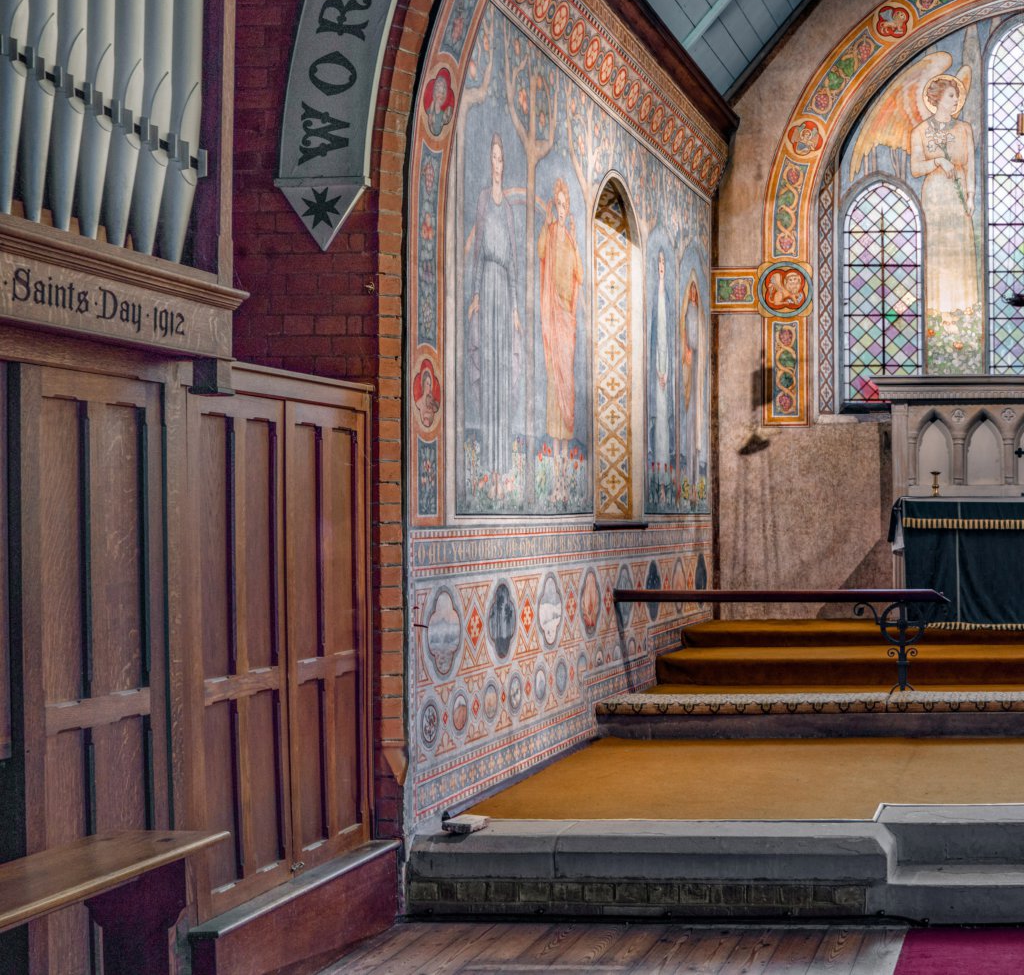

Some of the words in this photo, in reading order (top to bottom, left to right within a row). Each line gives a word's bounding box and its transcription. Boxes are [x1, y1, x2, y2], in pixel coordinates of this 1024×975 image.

[12, 268, 89, 315] Saints
[96, 286, 142, 334] Day
[153, 306, 186, 338] 1912
